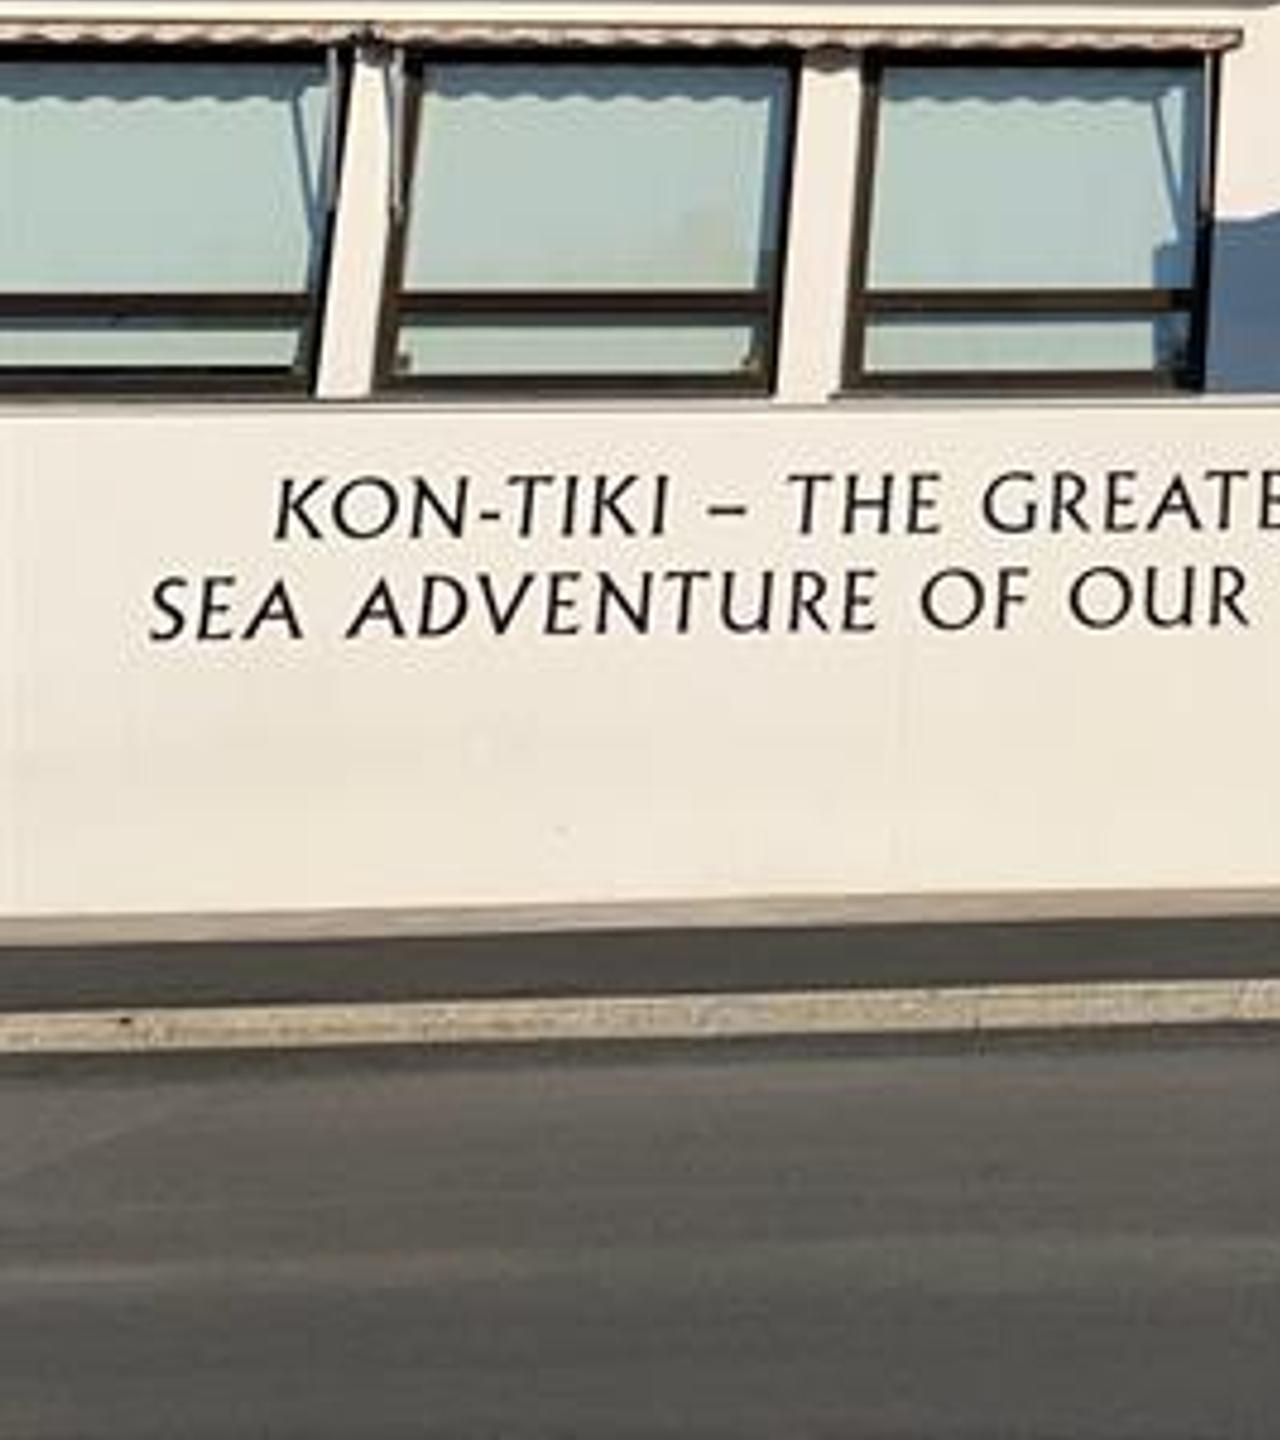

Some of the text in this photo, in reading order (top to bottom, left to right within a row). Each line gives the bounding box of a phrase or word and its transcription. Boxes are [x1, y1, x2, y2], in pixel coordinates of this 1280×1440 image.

[275, 475, 668, 540] KON-TIKI
[788, 473, 940, 534] THE
[150, 577, 302, 641] SEA
[346, 570, 876, 638] ADVENTURE
[921, 567, 1028, 630] OF
[1070, 566, 1248, 629] OUR
